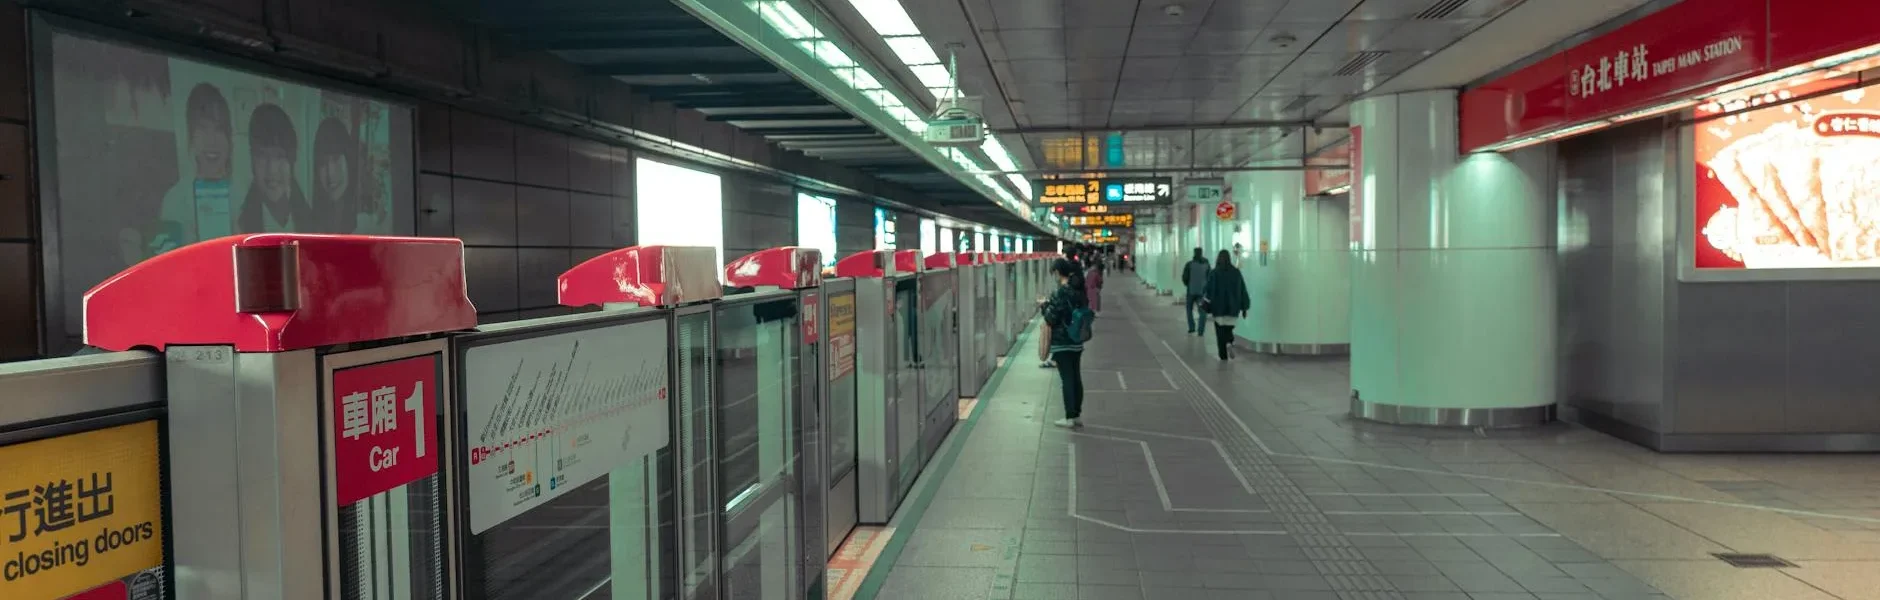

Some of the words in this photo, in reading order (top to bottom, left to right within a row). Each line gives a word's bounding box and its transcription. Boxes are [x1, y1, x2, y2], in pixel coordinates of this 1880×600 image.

[1581, 44, 1648, 98] 台北車站
[1652, 57, 1676, 77] TAIPEI
[1677, 49, 1702, 69] MAIN
[1703, 36, 1743, 62] STATION
[341, 385, 397, 442] 車廂
[404, 380, 426, 459] 1
[369, 444, 400, 473] Car
[4, 538, 89, 582] closing
[95, 521, 153, 554] doors
